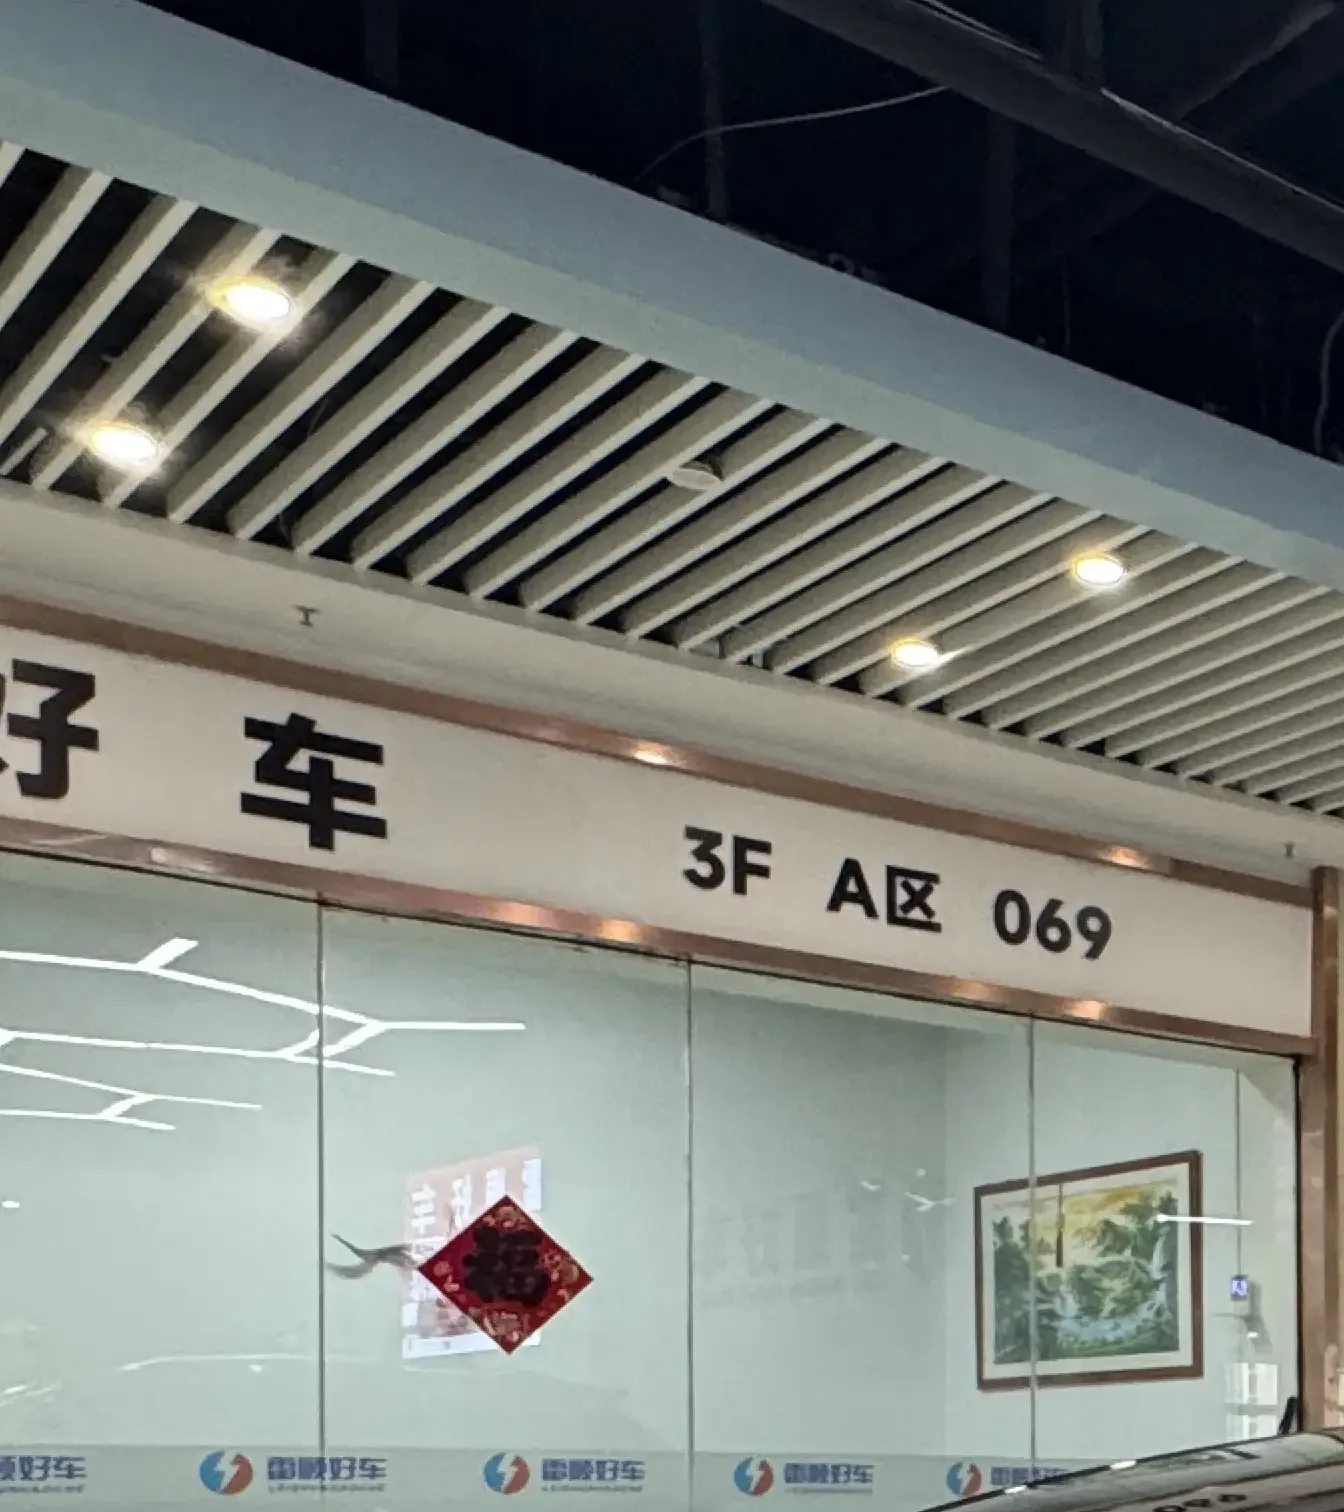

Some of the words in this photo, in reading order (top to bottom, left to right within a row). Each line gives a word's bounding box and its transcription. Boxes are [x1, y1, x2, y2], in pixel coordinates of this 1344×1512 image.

[682, 825, 772, 896] 3F
[826, 857, 943, 934] A区
[992, 889, 1113, 961] 069
